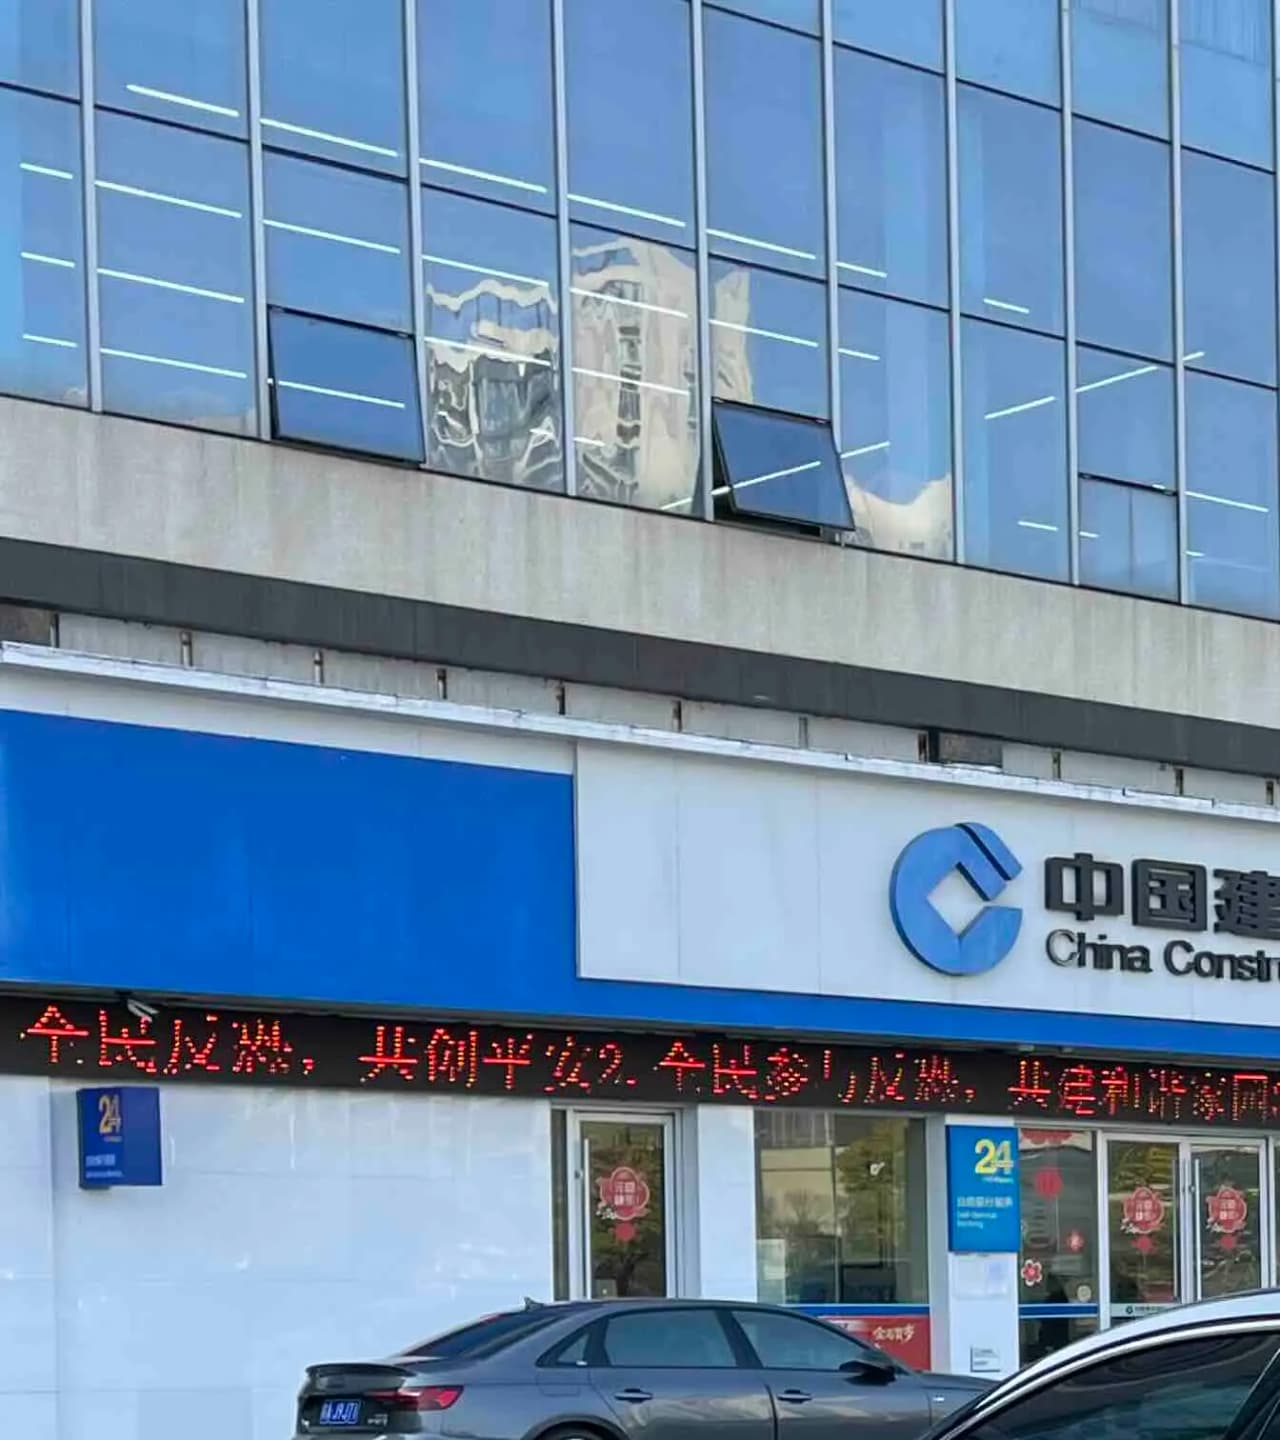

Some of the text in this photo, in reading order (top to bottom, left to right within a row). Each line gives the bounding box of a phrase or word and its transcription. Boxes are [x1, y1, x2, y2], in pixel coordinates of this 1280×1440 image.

[1045, 929, 1151, 973] China
[98, 1094, 121, 1133] 24
[975, 1139, 1014, 1175] 24
